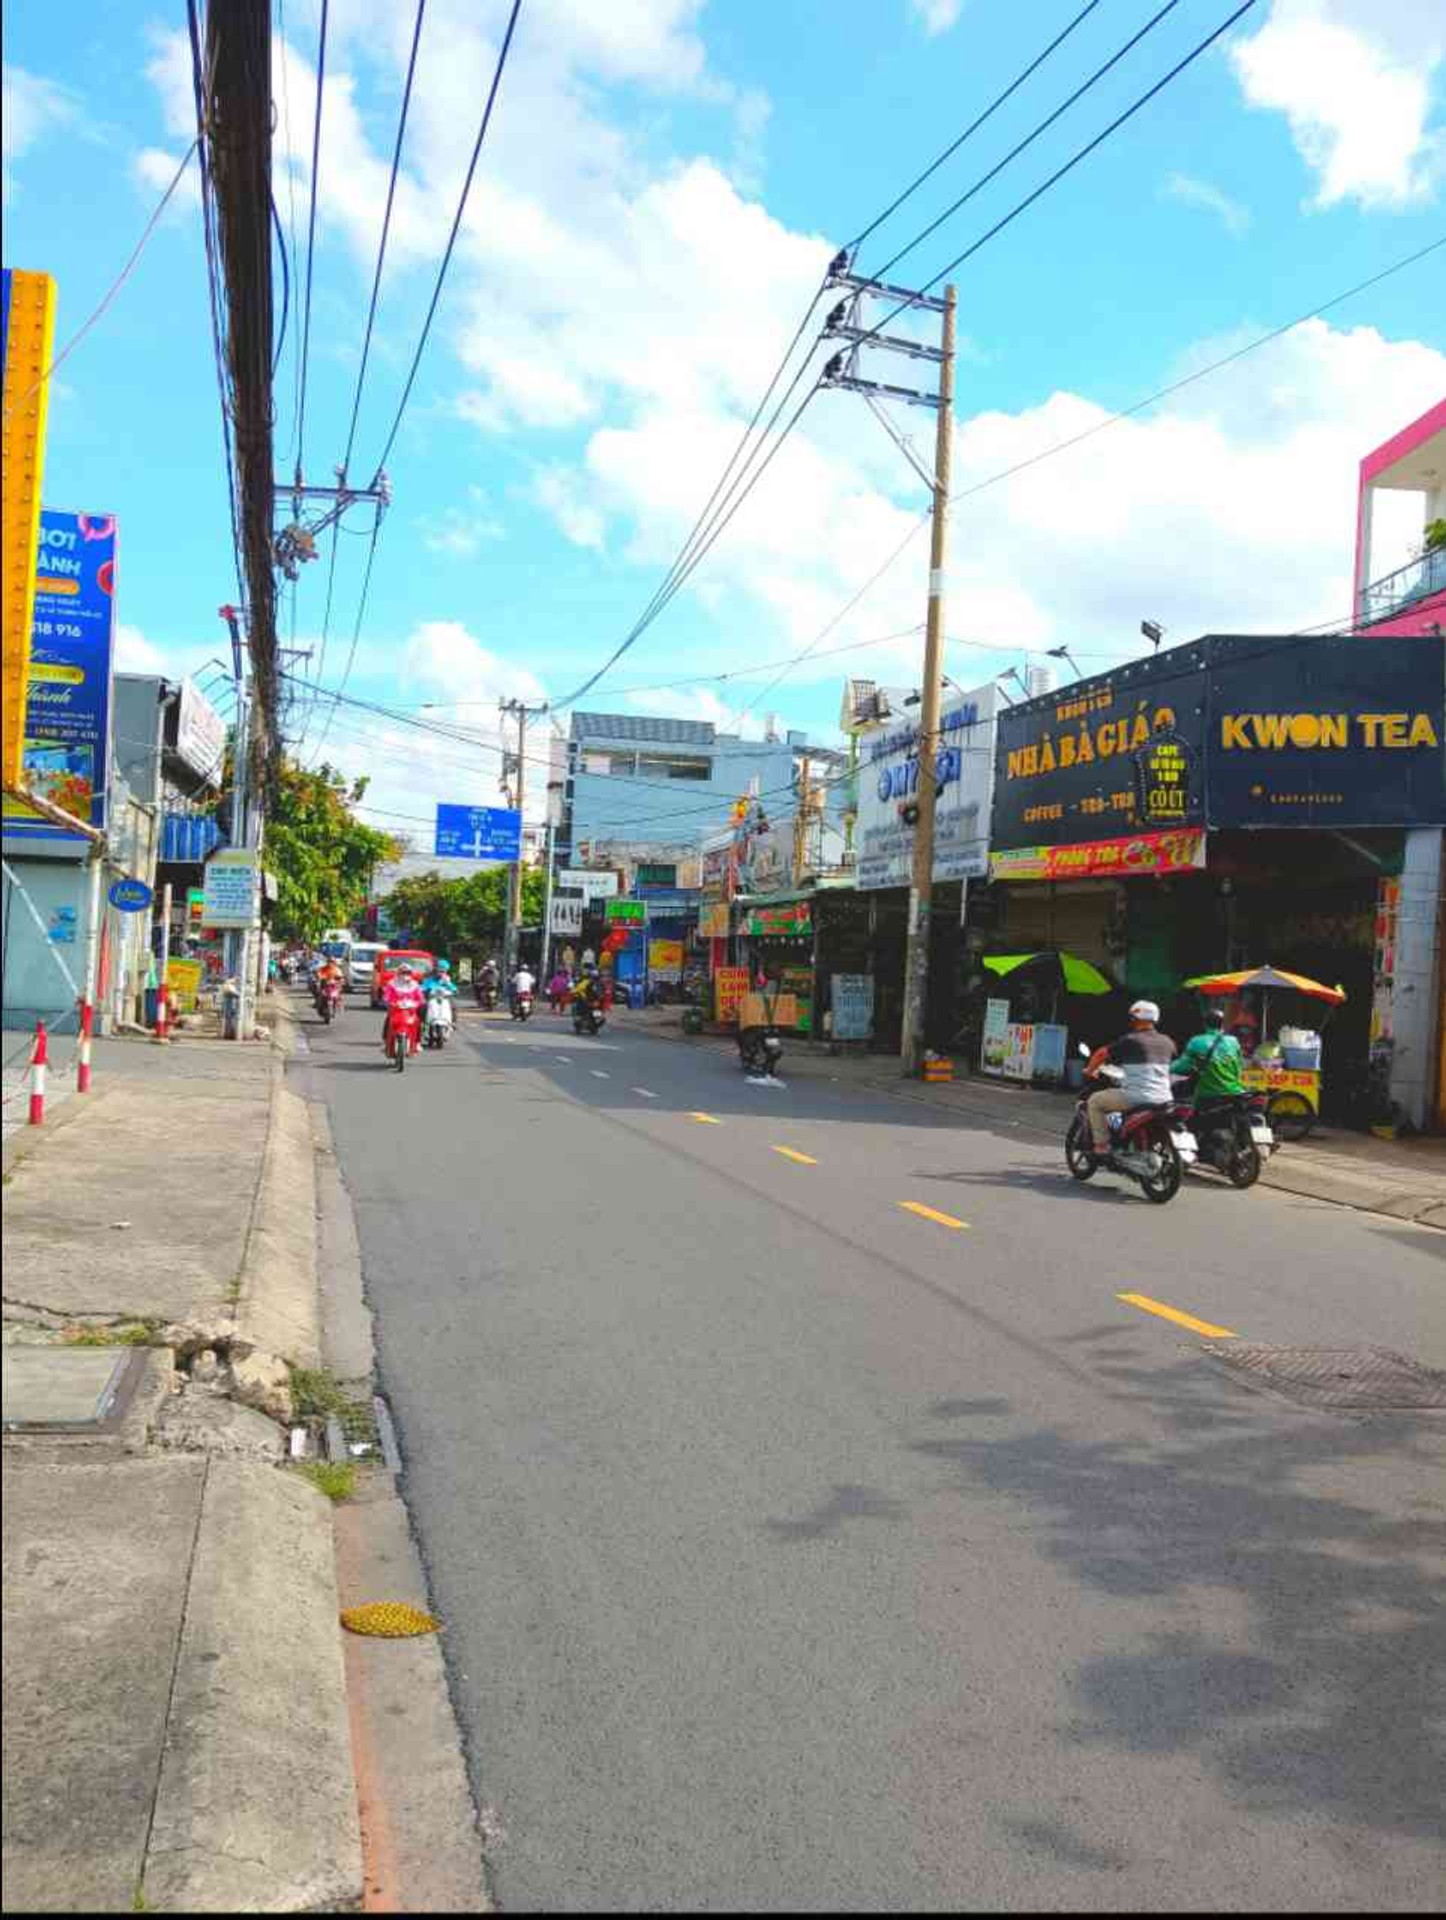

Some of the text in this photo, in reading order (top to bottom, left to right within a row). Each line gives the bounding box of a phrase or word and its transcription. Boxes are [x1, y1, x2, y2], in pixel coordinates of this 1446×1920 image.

[56, 623, 82, 638] 916
[1222, 712, 1438, 749] KWON TEA
[1007, 731, 1057, 781] NHÀ
[1060, 719, 1095, 768] BÀ
